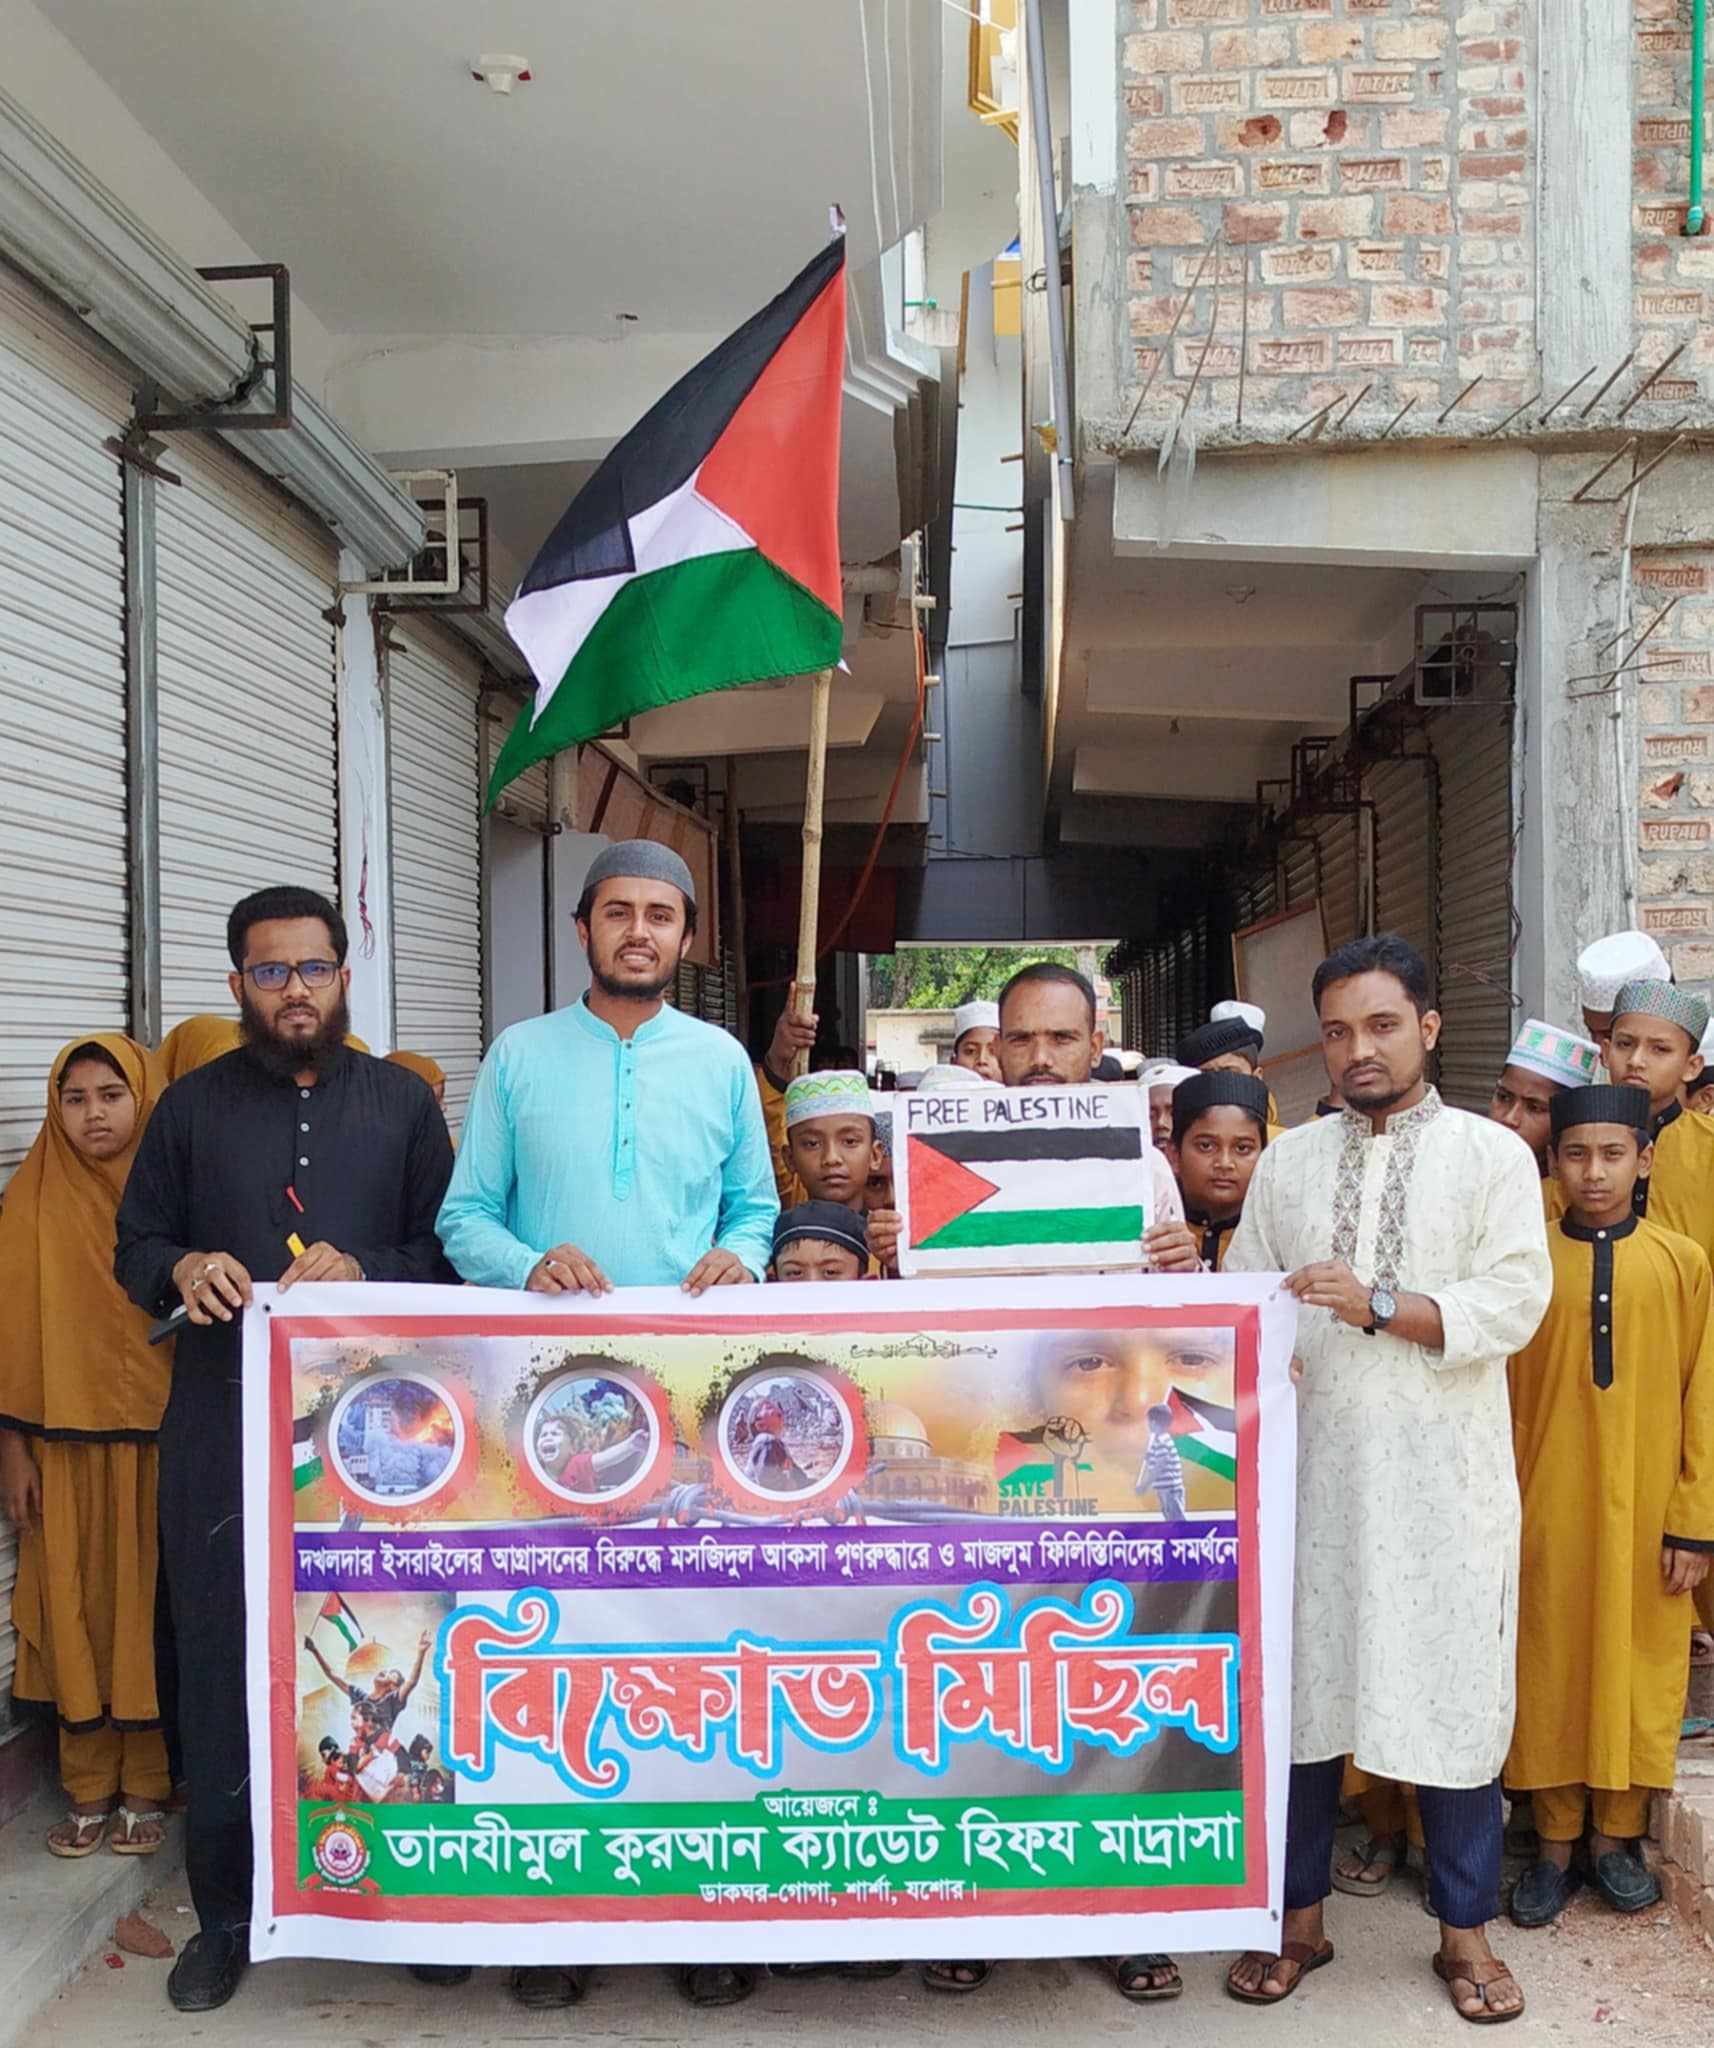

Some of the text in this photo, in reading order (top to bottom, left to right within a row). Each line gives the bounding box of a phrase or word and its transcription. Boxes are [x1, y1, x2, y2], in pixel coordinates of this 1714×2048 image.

[907, 1095, 1109, 1129] FREE PALESTINE
[998, 1481, 1046, 1498] SAVE
[998, 1498, 1098, 1517] PALESTINE
[298, 1547, 375, 1577] দখলদার
[380, 1540, 485, 1579] ইসরাইলের
[489, 1544, 591, 1576] আগ্রাসনের
[596, 1536, 664, 1574] বিরুদ্ধে
[668, 1535, 756, 1579] মসজিদুল
[760, 1542, 828, 1572] আকসা
[938, 1544, 956, 1567] ও
[961, 1538, 1034, 1576] মাজলুম
[1170, 1527, 1239, 1566] সমর্থনে
[444, 1588, 1234, 1790] বিক্ষোভ মিছিল
[382, 1811, 590, 1885] তানযীমুল
[600, 1820, 769, 1886] কুরআন
[778, 1808, 946, 1871] ক্যাডেট
[1091, 1809, 1242, 1869] মাদ্রাসা
